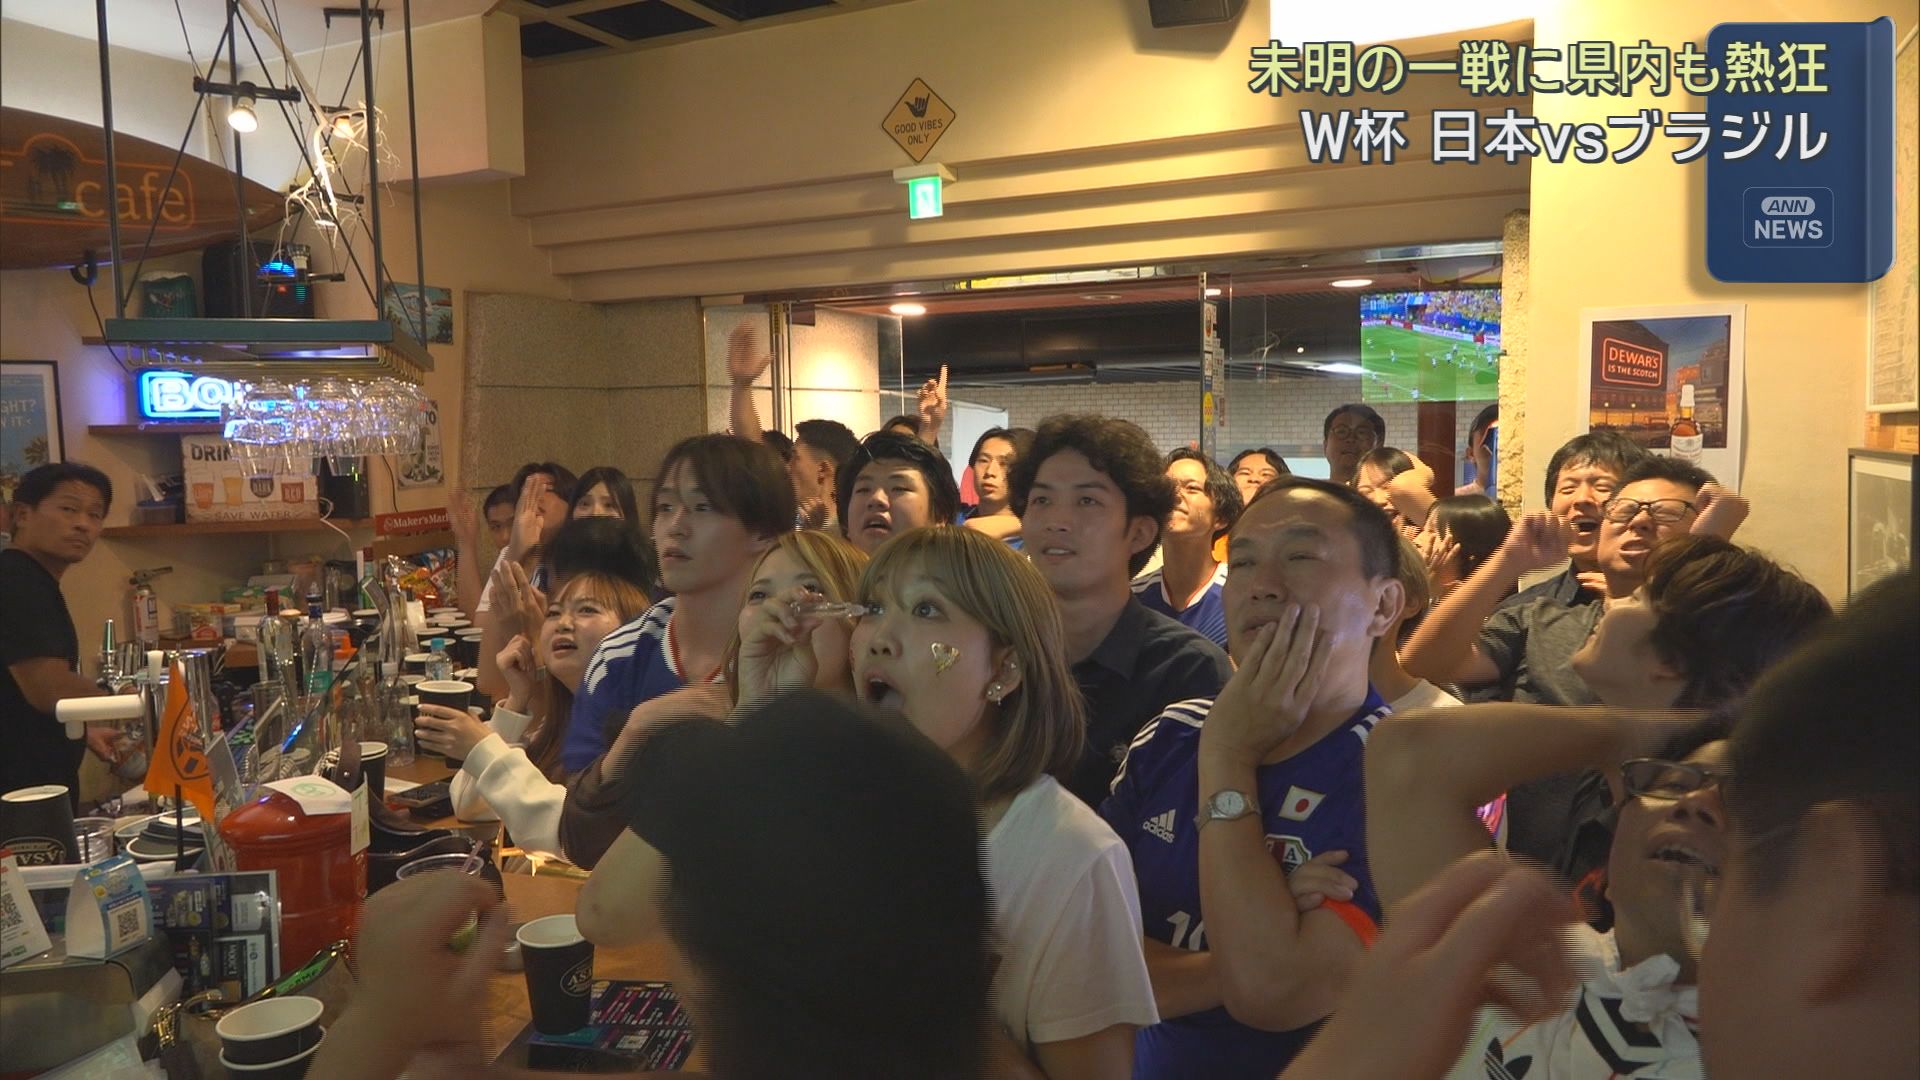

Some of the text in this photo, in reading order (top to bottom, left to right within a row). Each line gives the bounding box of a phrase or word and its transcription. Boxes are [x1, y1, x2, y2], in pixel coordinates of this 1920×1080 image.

[895, 119, 943, 134] GOOD VIBES
[907, 134, 929, 145] ONLY
[75, 171, 188, 223] cafe
[1609, 347, 1659, 369] DEWAR'S
[1617, 366, 1631, 375] THE
[1633, 368, 1658, 378] SCOTCH
[214, 511, 245, 521] SAVE
[392, 515, 430, 529] Maker's
[1142, 820, 1175, 843] adidas
